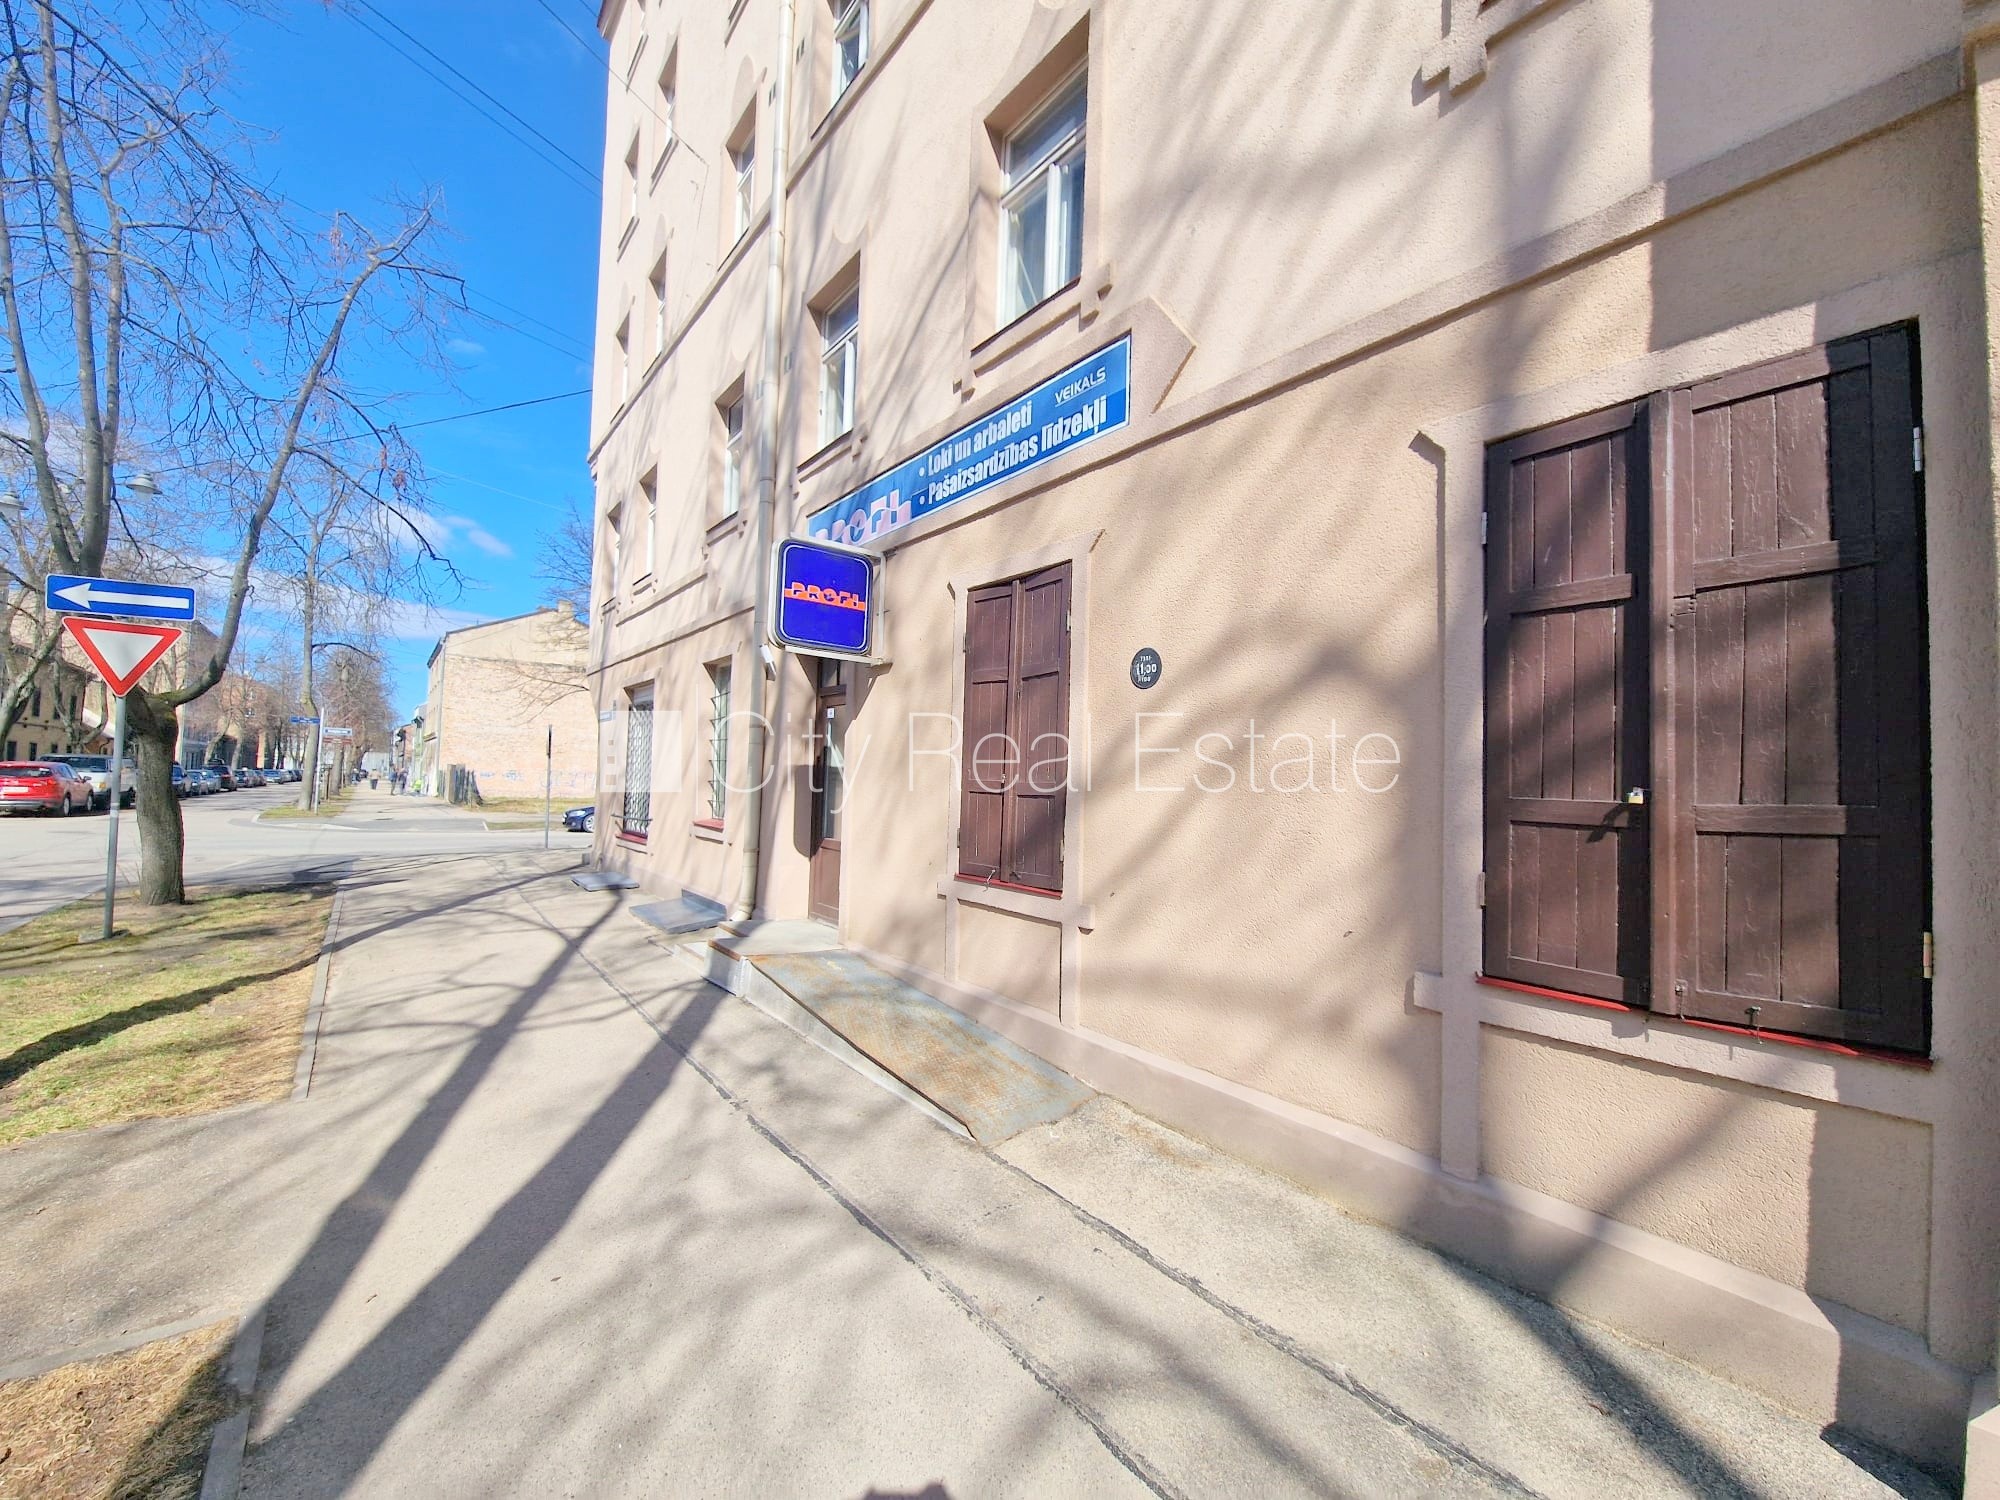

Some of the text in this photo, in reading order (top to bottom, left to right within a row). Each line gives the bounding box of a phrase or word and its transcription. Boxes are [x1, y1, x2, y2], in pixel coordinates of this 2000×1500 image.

[1054, 366, 1106, 404] VEIKALS
[928, 400, 1033, 476] Loki un arbaleti
[928, 394, 1107, 504] Pašaizsardzības līdzekļi
[815, 489, 900, 545] ROFI
[791, 581, 860, 608] PROFI
